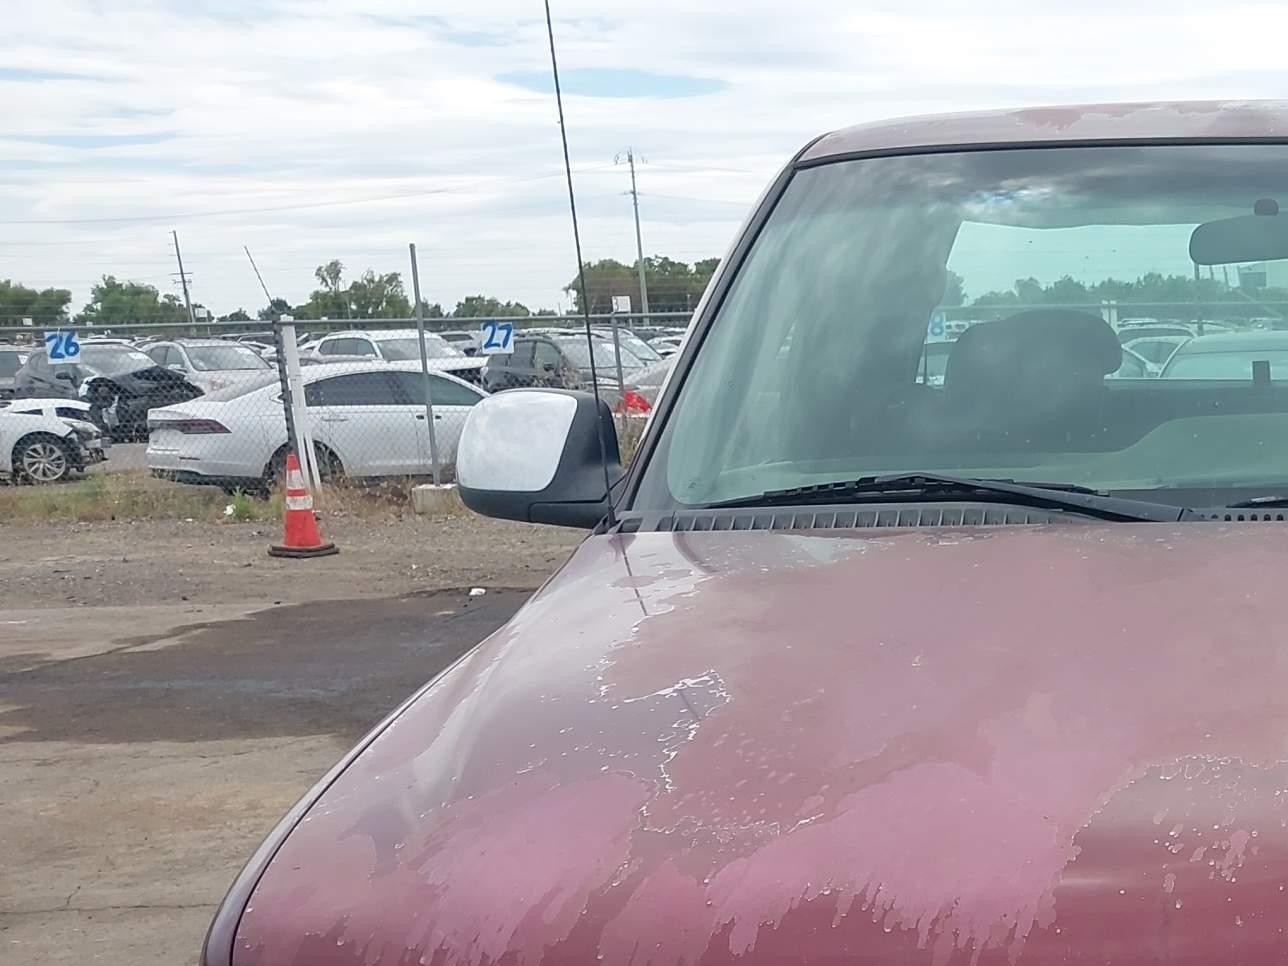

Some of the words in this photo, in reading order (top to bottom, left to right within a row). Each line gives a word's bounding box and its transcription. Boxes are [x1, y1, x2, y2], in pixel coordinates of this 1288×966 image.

[482, 320, 512, 349] 27
[930, 311, 945, 337] 8
[46, 330, 80, 359] 26
